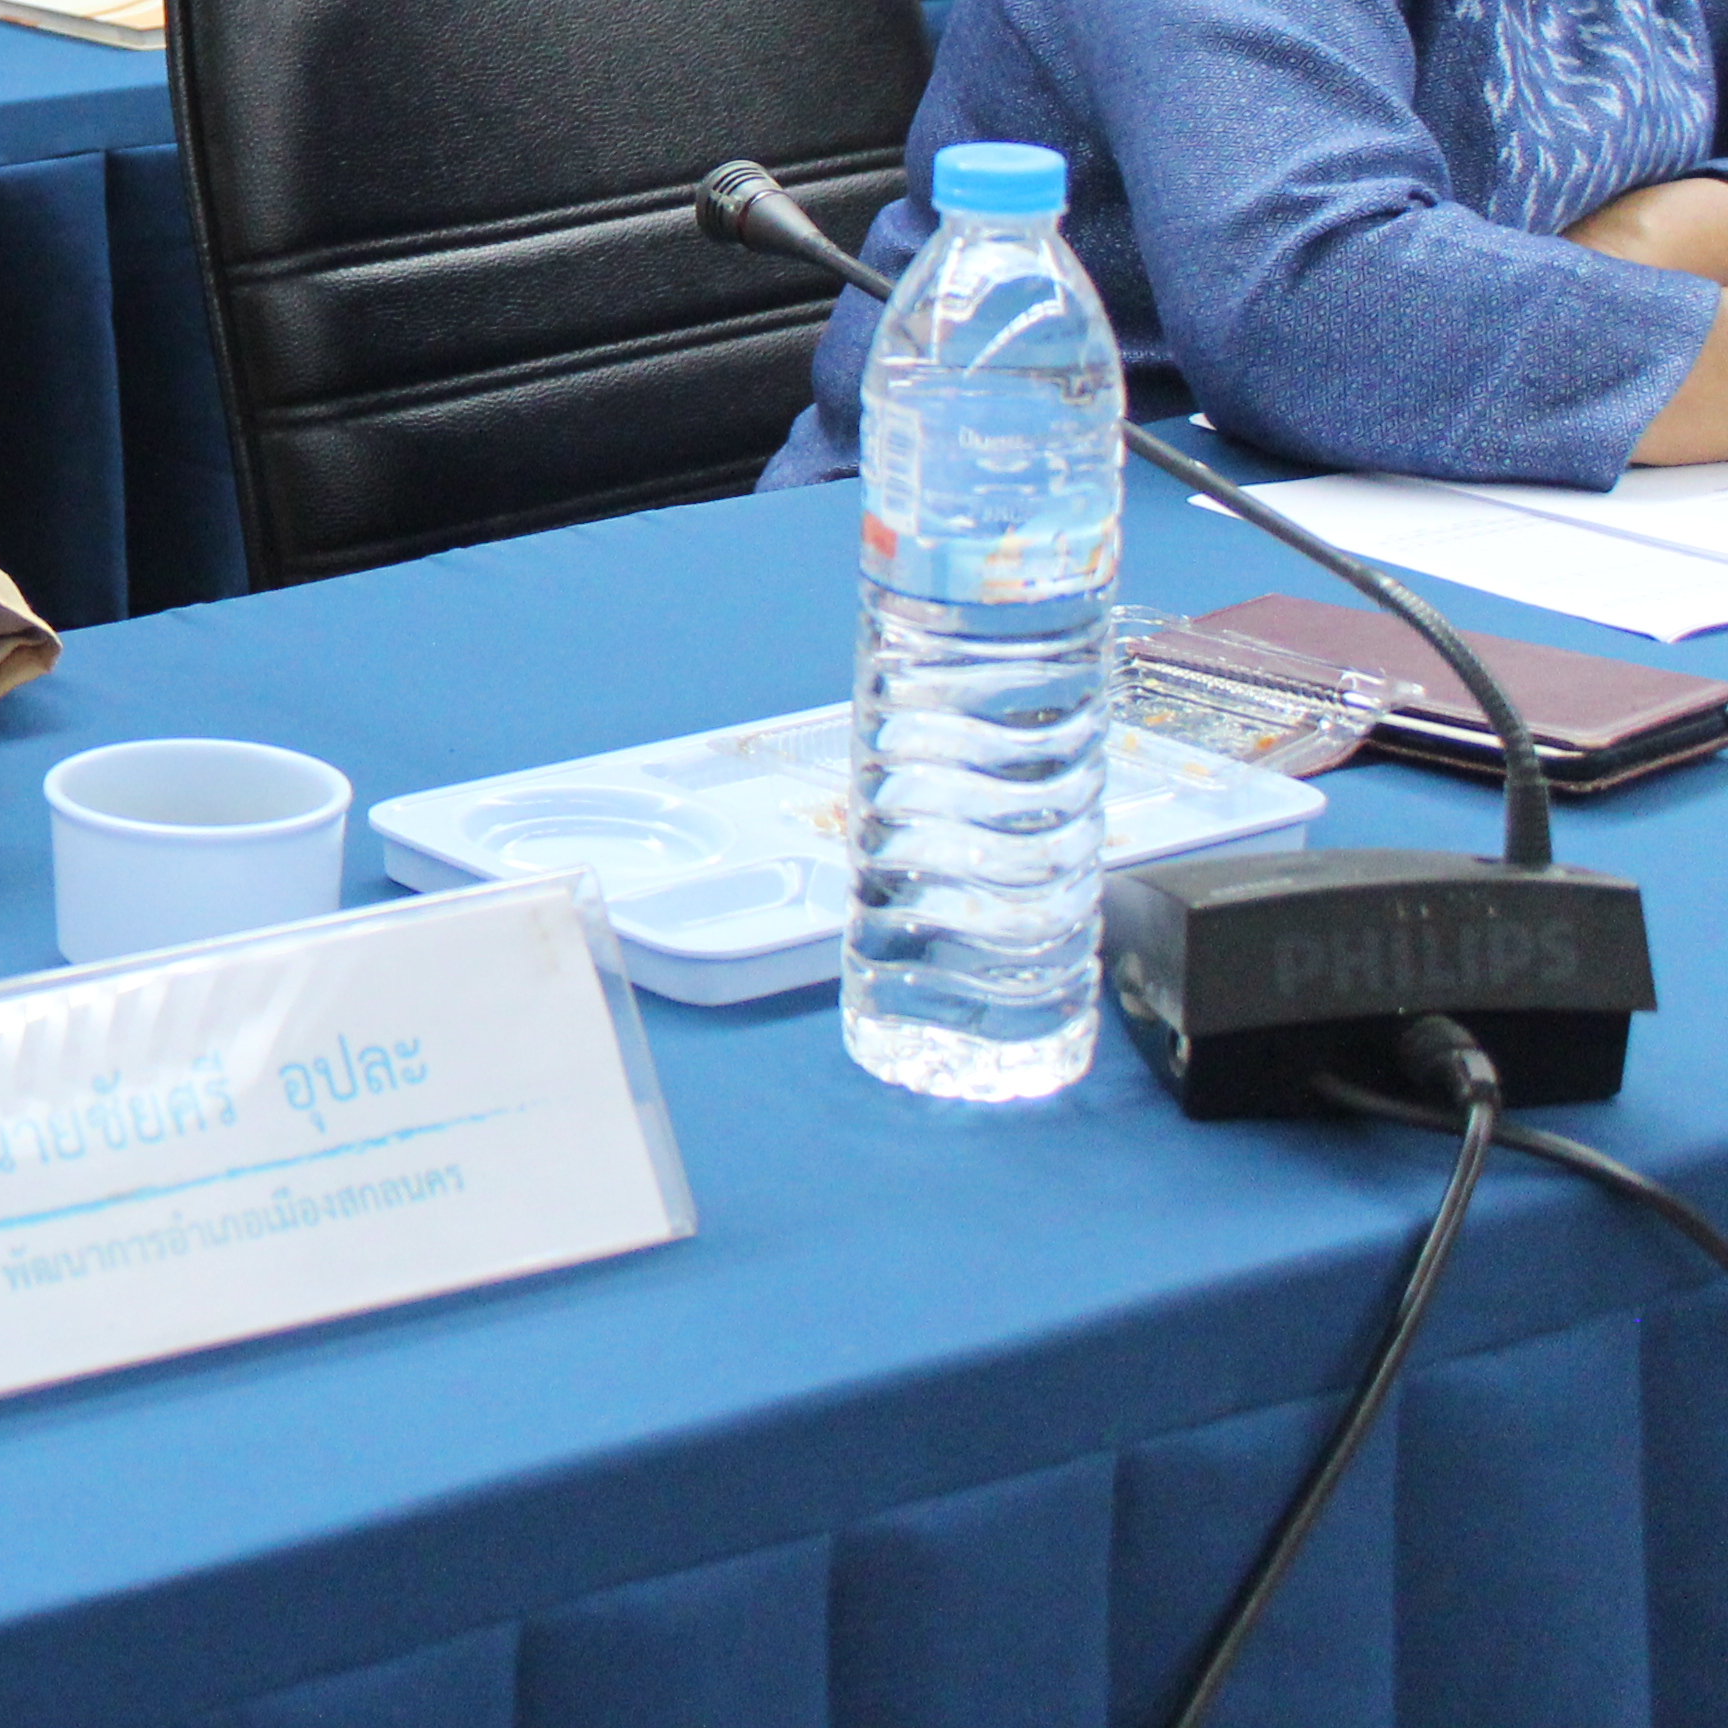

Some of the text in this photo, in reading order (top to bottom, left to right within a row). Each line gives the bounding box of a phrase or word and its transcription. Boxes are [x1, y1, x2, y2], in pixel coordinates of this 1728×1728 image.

[1273, 917, 1579, 998] PHILIPS
[277, 1033, 430, 1134] อุปละ
[0, 1162, 468, 1292] พัฒนาการอำเภอเมืองสกลนคร
